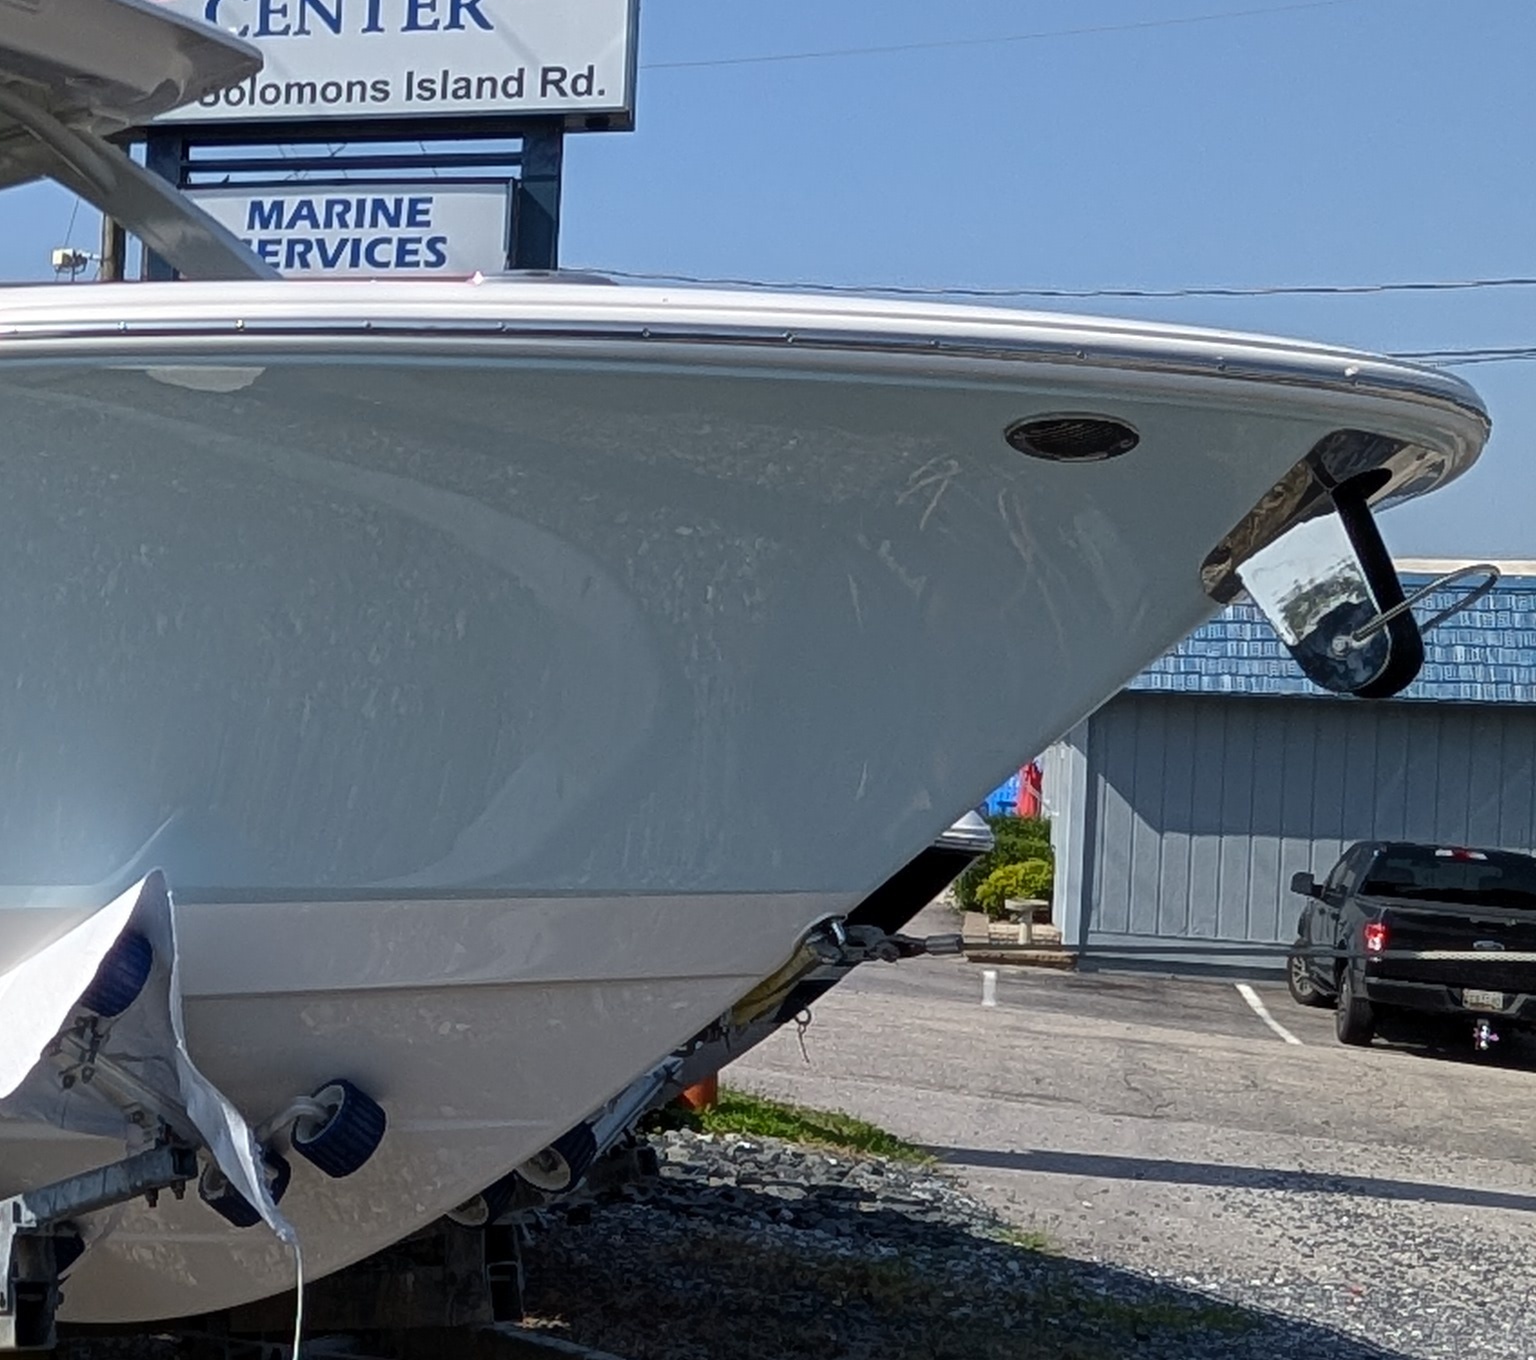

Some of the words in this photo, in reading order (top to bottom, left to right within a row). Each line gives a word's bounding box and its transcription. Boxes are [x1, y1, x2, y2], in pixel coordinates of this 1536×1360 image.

[405, 67, 525, 102] Island
[539, 64, 606, 99] Rd.
[246, 196, 434, 230] MARINE
